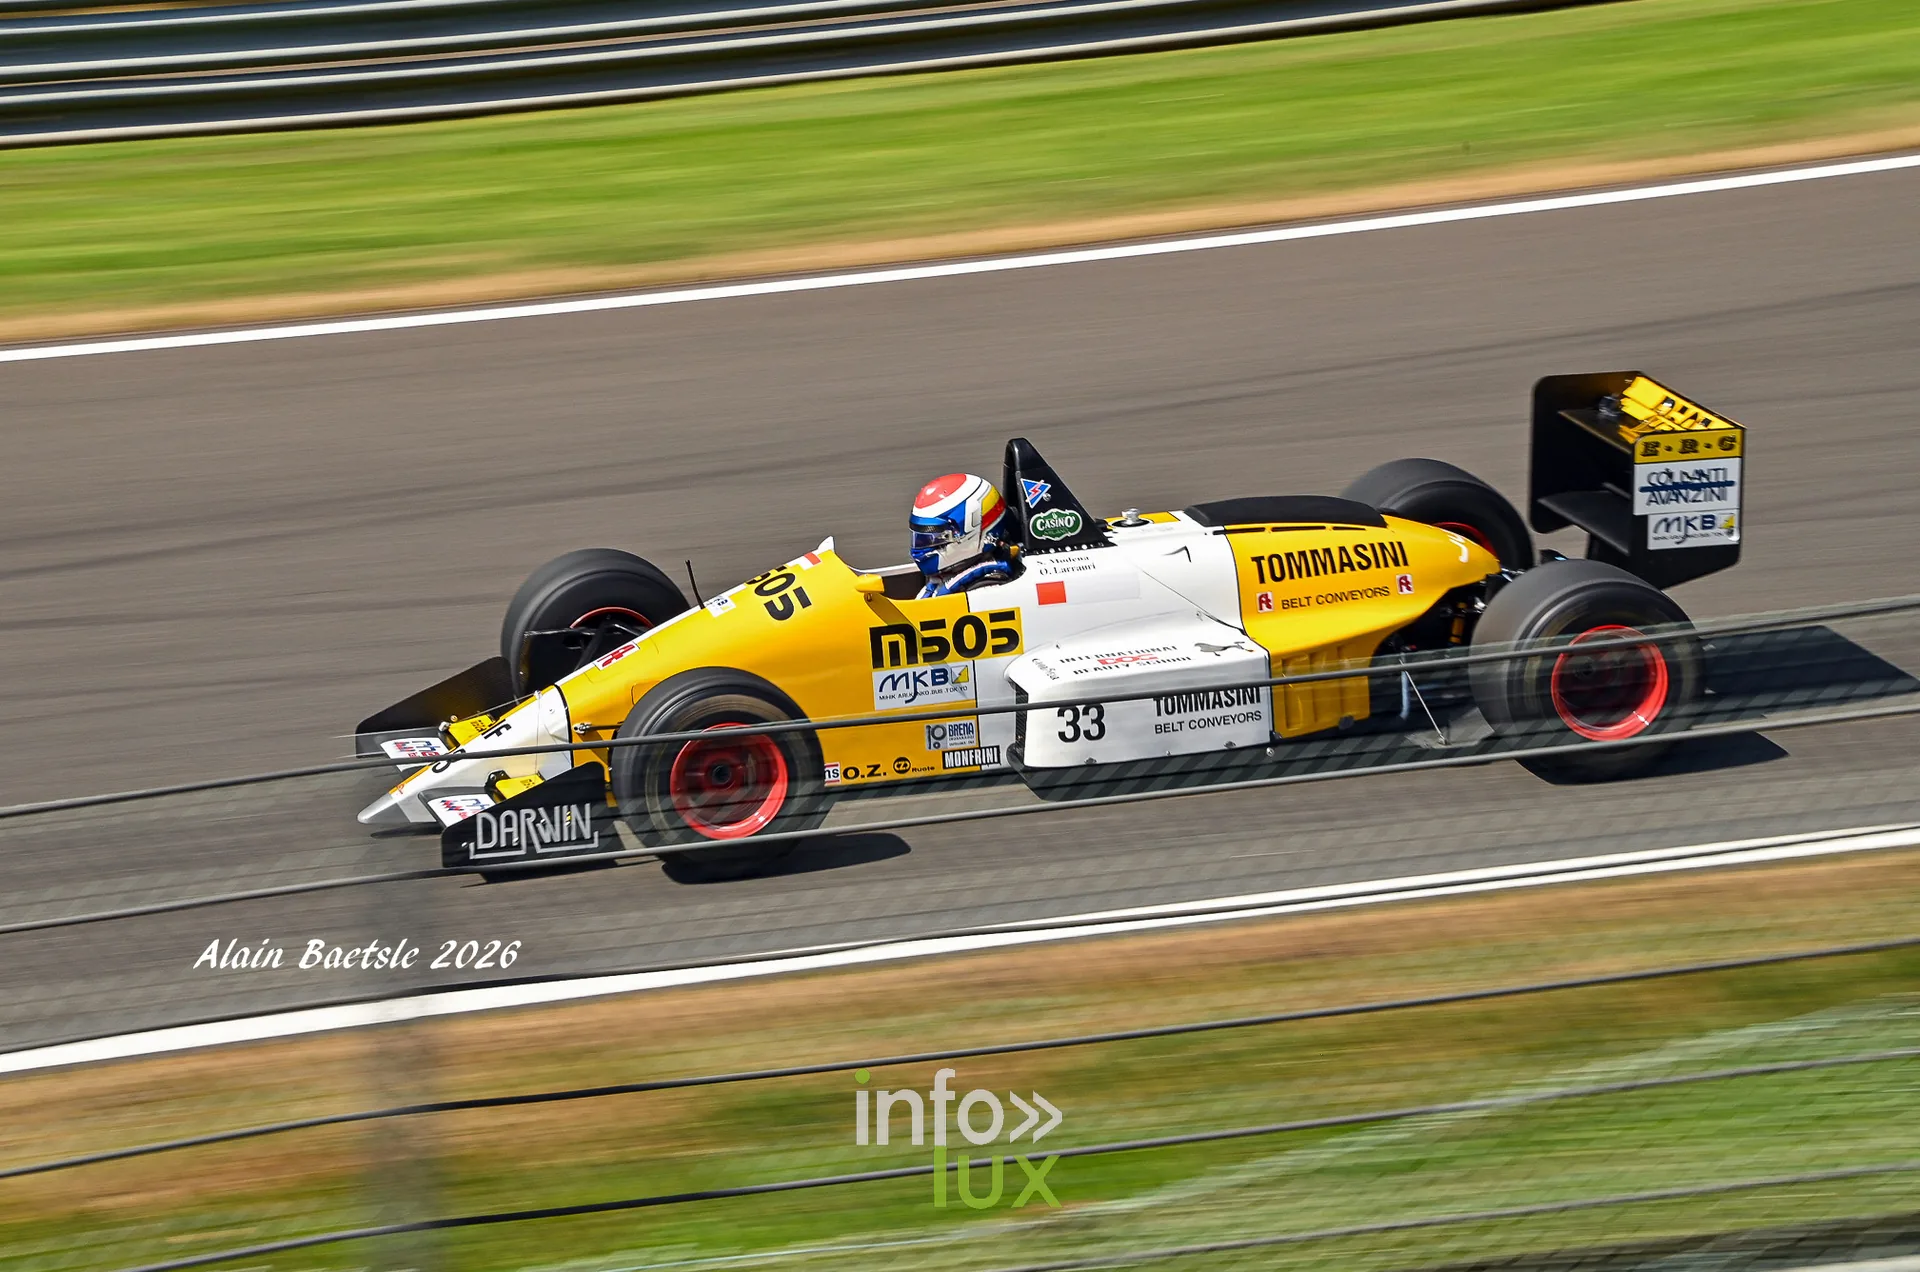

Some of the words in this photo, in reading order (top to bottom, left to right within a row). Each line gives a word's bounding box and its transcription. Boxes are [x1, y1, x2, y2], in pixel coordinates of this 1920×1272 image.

[1053, 563, 1096, 575] Larrauri
[1251, 541, 1409, 584] TOMMASINI
[1281, 595, 1312, 610] BELT
[1315, 586, 1391, 606] CONVEYORS
[1073, 662, 1131, 675] BEAUTY
[878, 667, 949, 704] MKB
[1152, 687, 1261, 717] TOMMASINI
[1056, 704, 1106, 743] 33
[1154, 721, 1185, 735] BELT
[1188, 711, 1262, 731] CONVEYORS
[944, 747, 999, 769] MONFRINI
[470, 803, 598, 859] DARWIN
